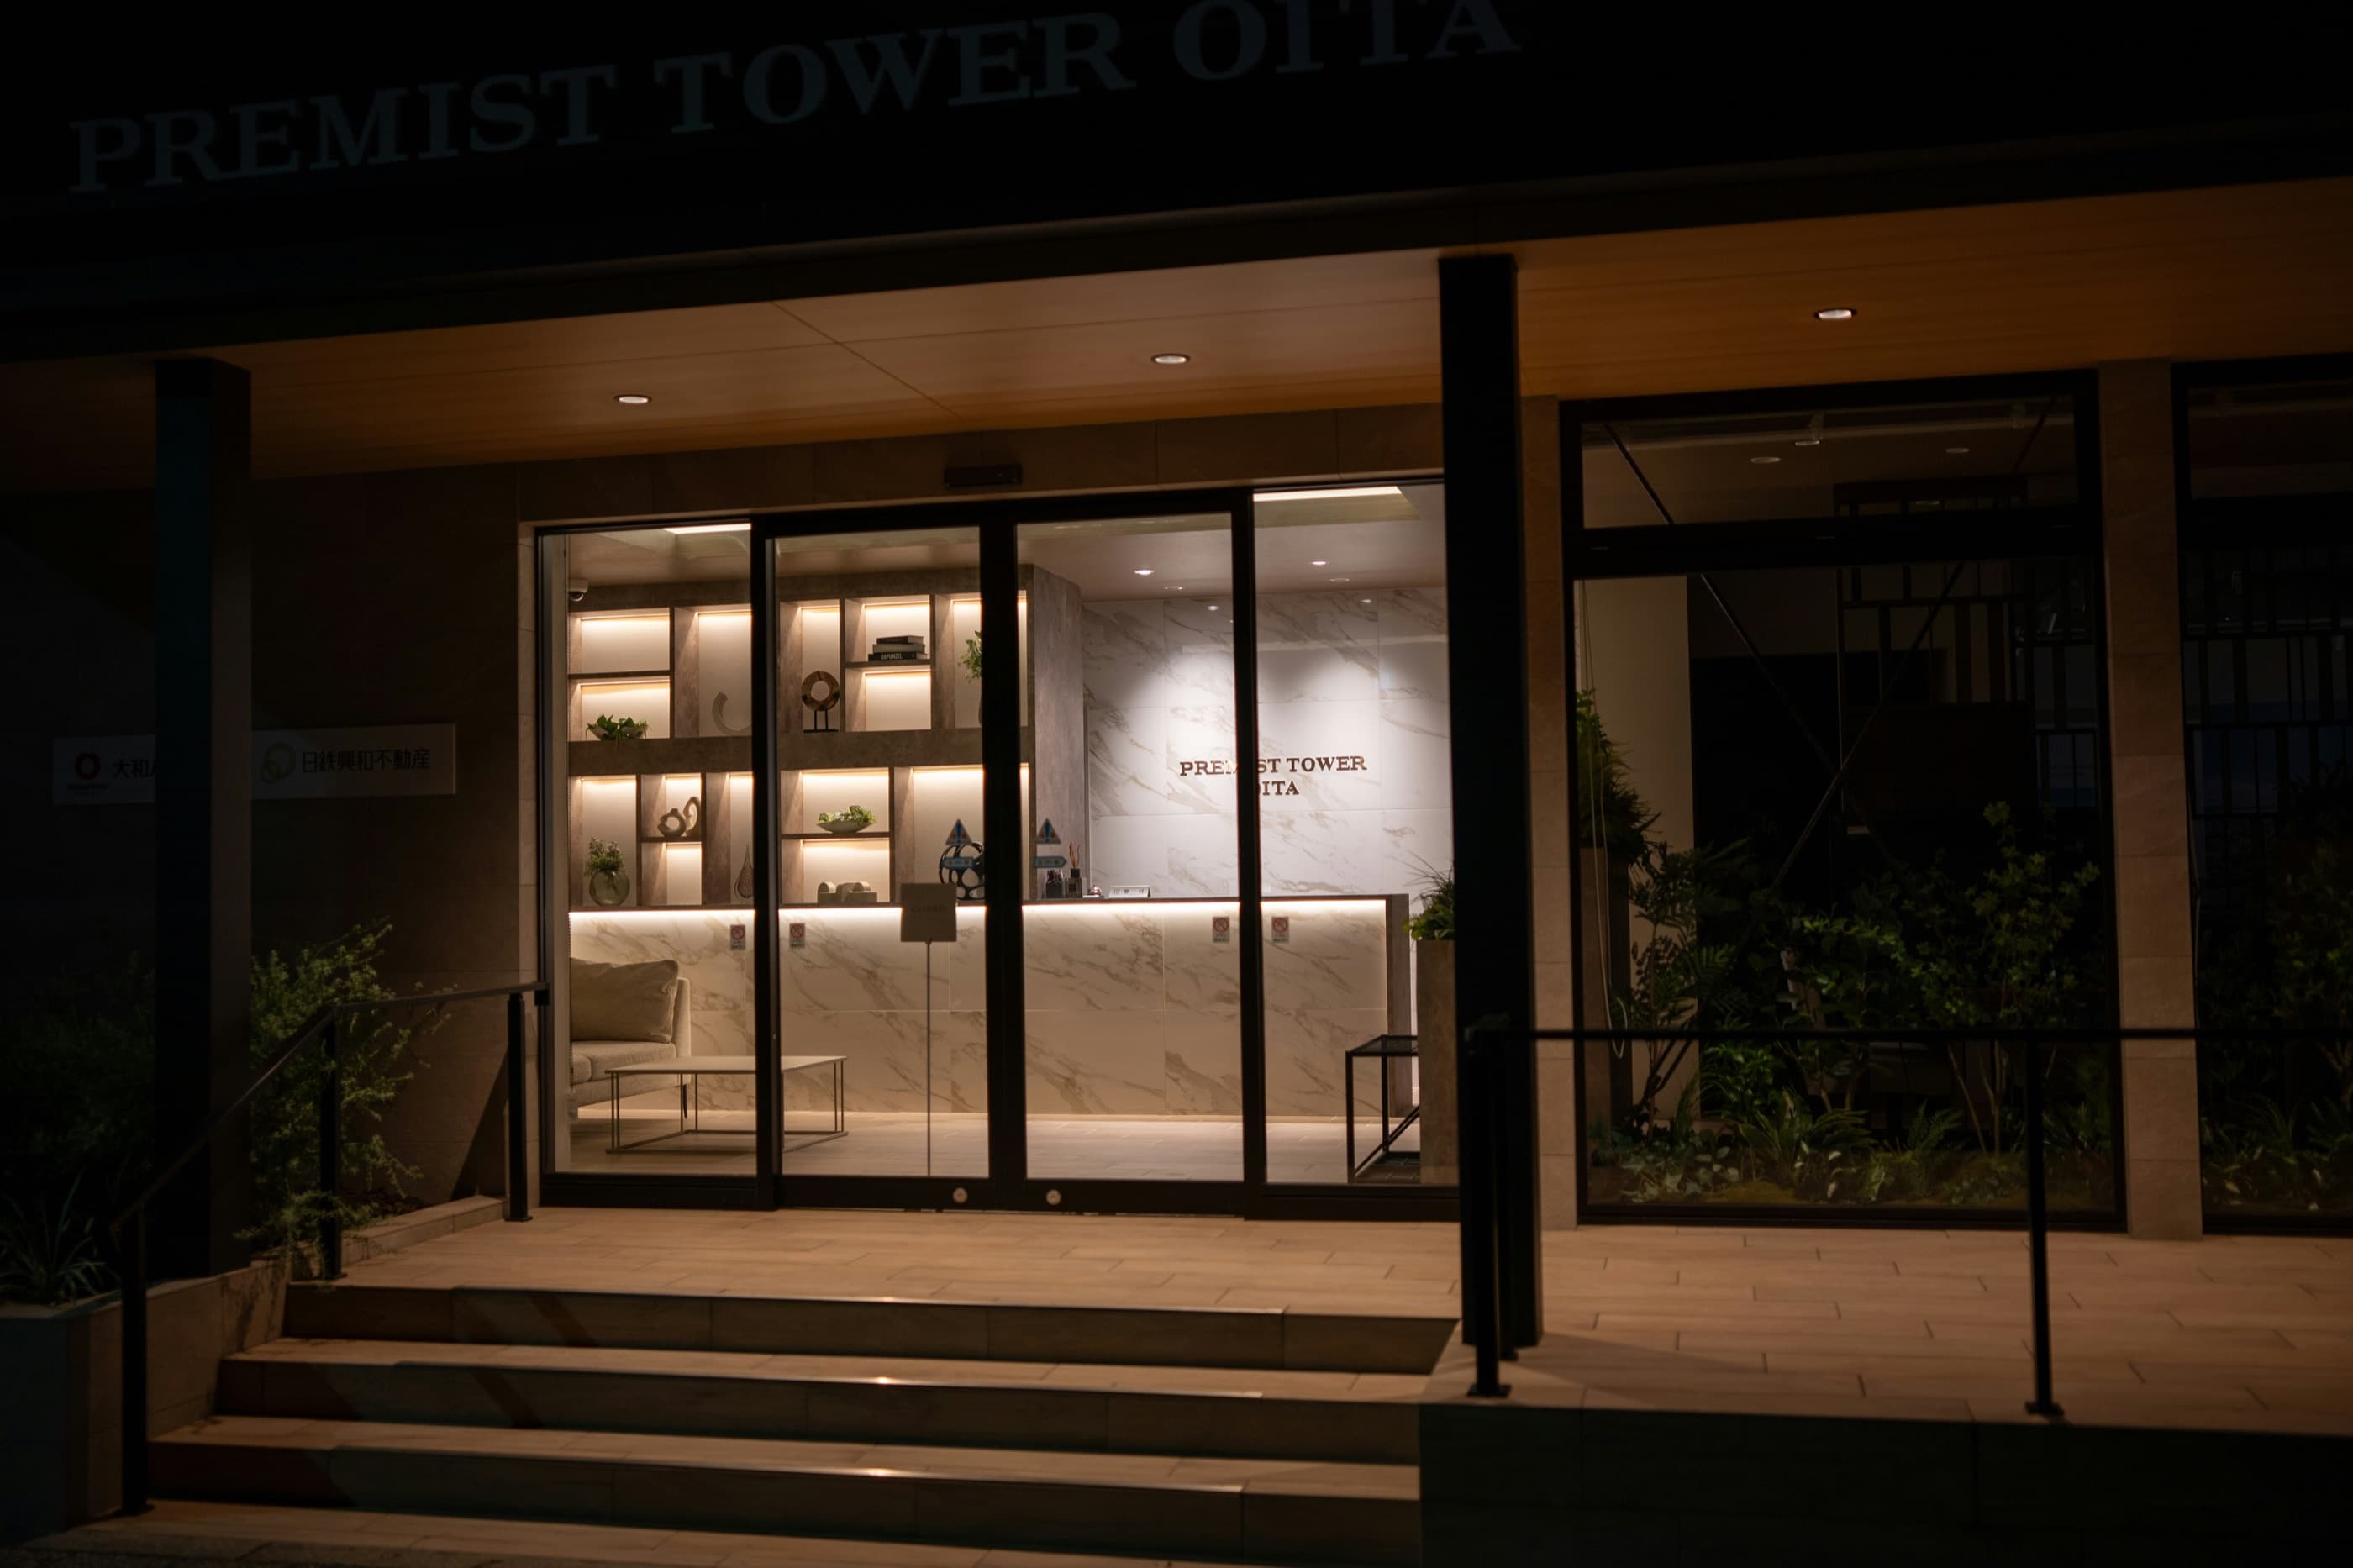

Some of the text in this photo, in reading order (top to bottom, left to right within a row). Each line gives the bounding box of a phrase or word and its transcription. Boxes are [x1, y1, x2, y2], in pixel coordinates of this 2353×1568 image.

[69, 0, 1523, 194] PREMIST TOWER OITA
[302, 747, 431, 773] 日鉄興和不動産
[1179, 755, 1368, 776] PREMST TOWER
[1258, 780, 1300, 796] ITA
